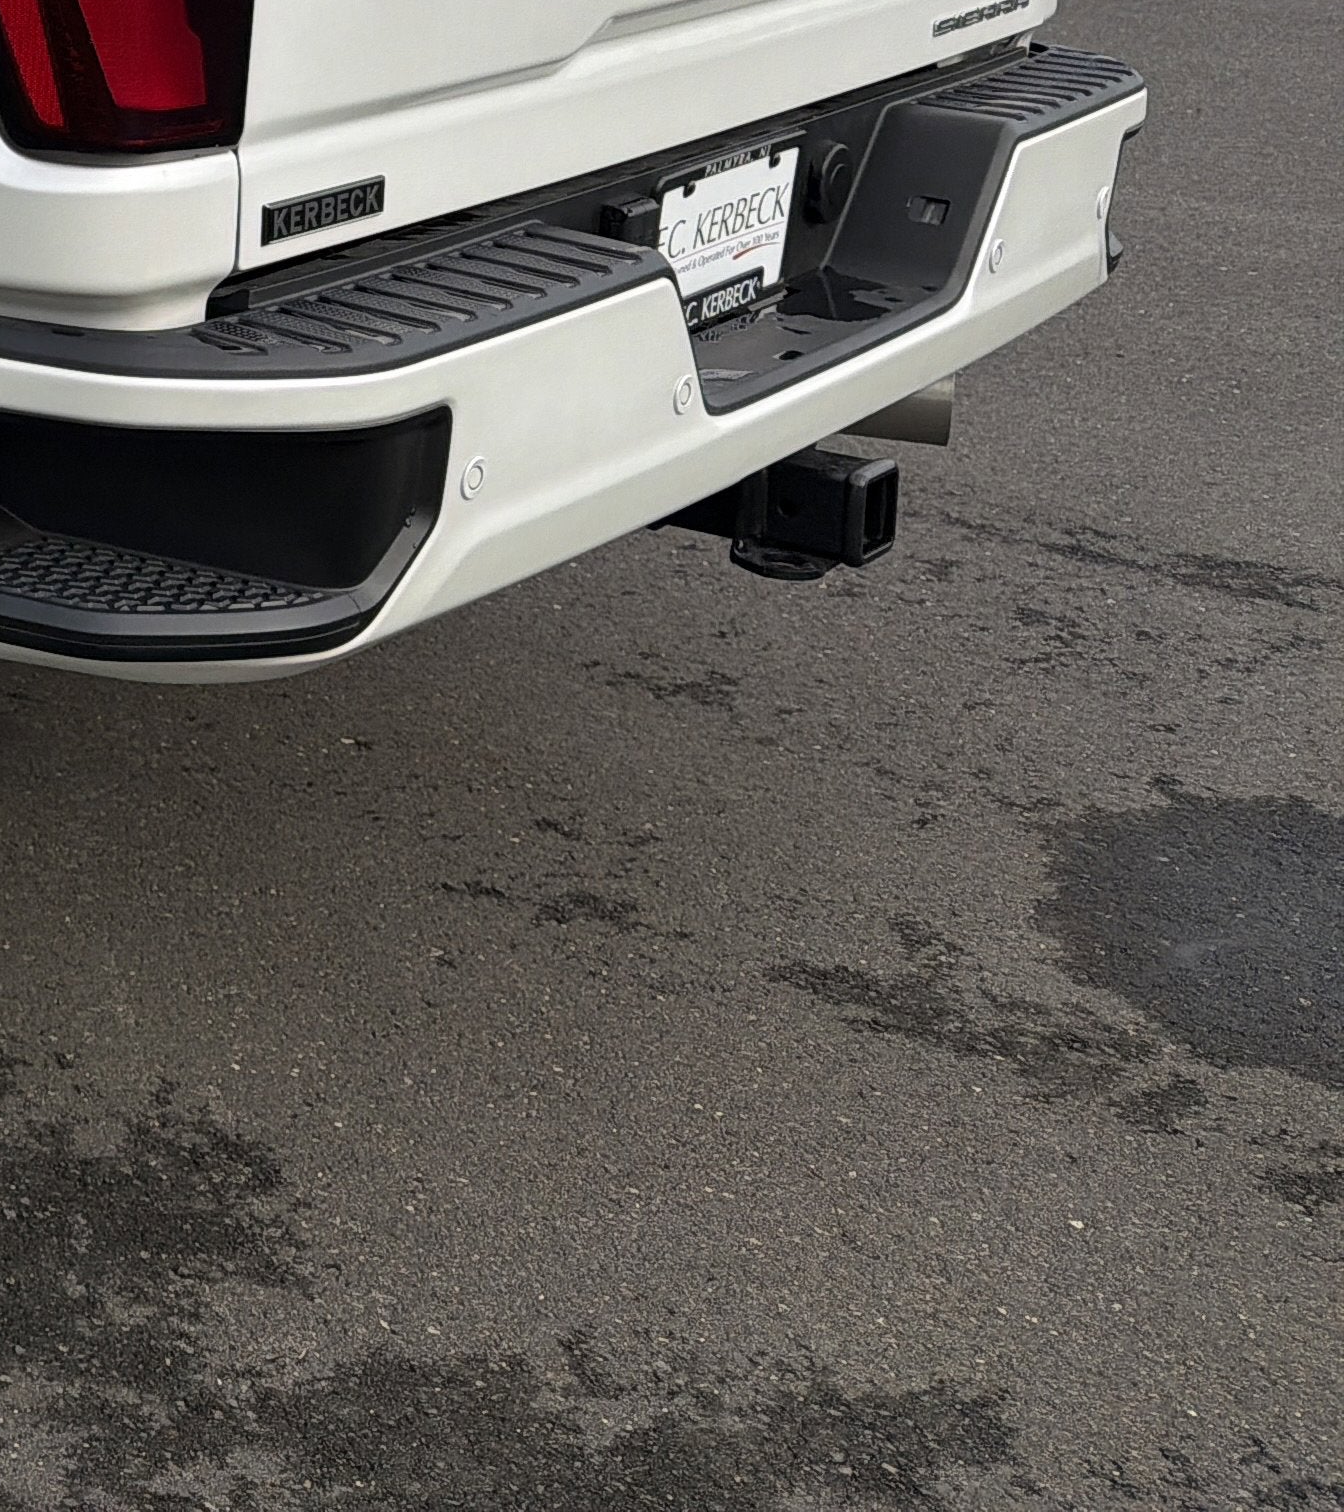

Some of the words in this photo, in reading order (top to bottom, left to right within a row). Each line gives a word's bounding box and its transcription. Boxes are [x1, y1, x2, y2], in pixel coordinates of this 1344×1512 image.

[273, 184, 380, 238] KERBECK
[693, 182, 790, 249] KERBECK
[698, 246, 725, 268] Operated
[736, 239, 751, 252] Over
[764, 230, 780, 242] Years
[700, 276, 758, 321] KERBECK
